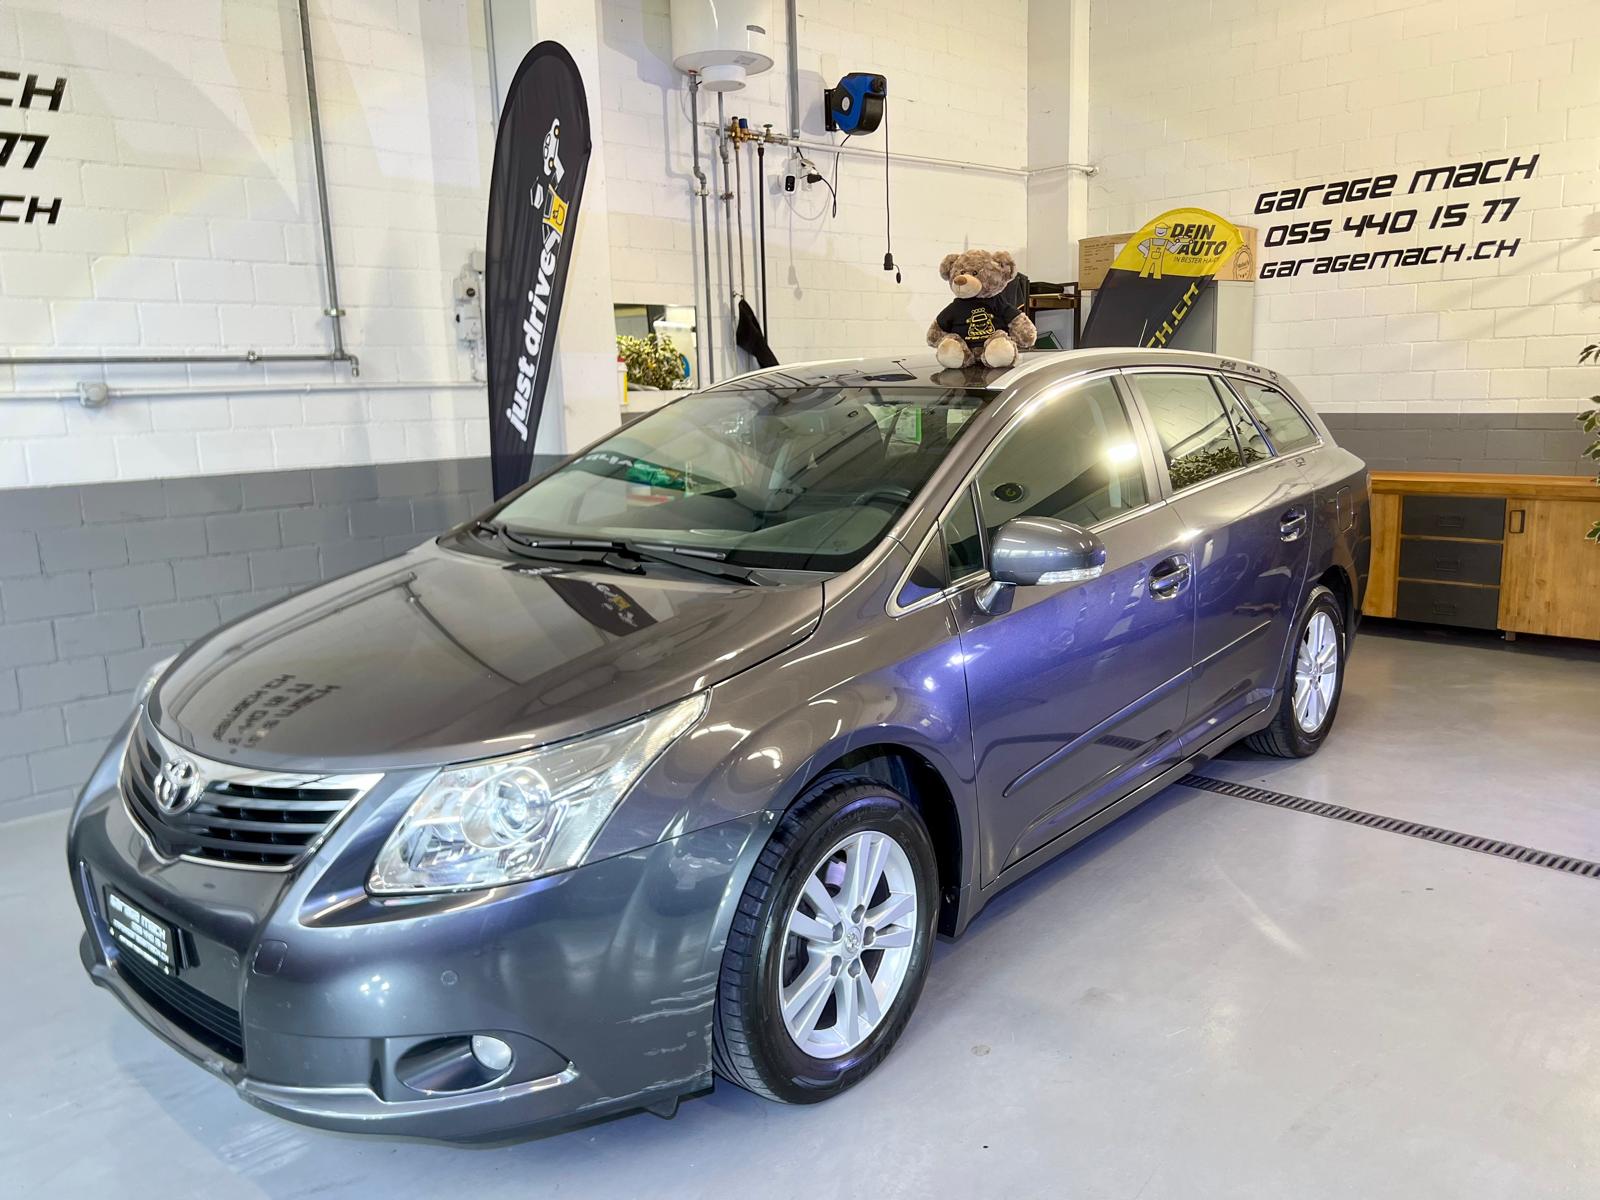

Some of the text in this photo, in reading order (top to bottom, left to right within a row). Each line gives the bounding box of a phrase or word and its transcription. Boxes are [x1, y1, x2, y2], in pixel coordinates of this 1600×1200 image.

[1170, 223, 1216, 241] DEIN
[1264, 197, 1520, 247] 055 440 15 77
[1177, 240, 1227, 256] AUTO
[506, 354, 536, 441] just
